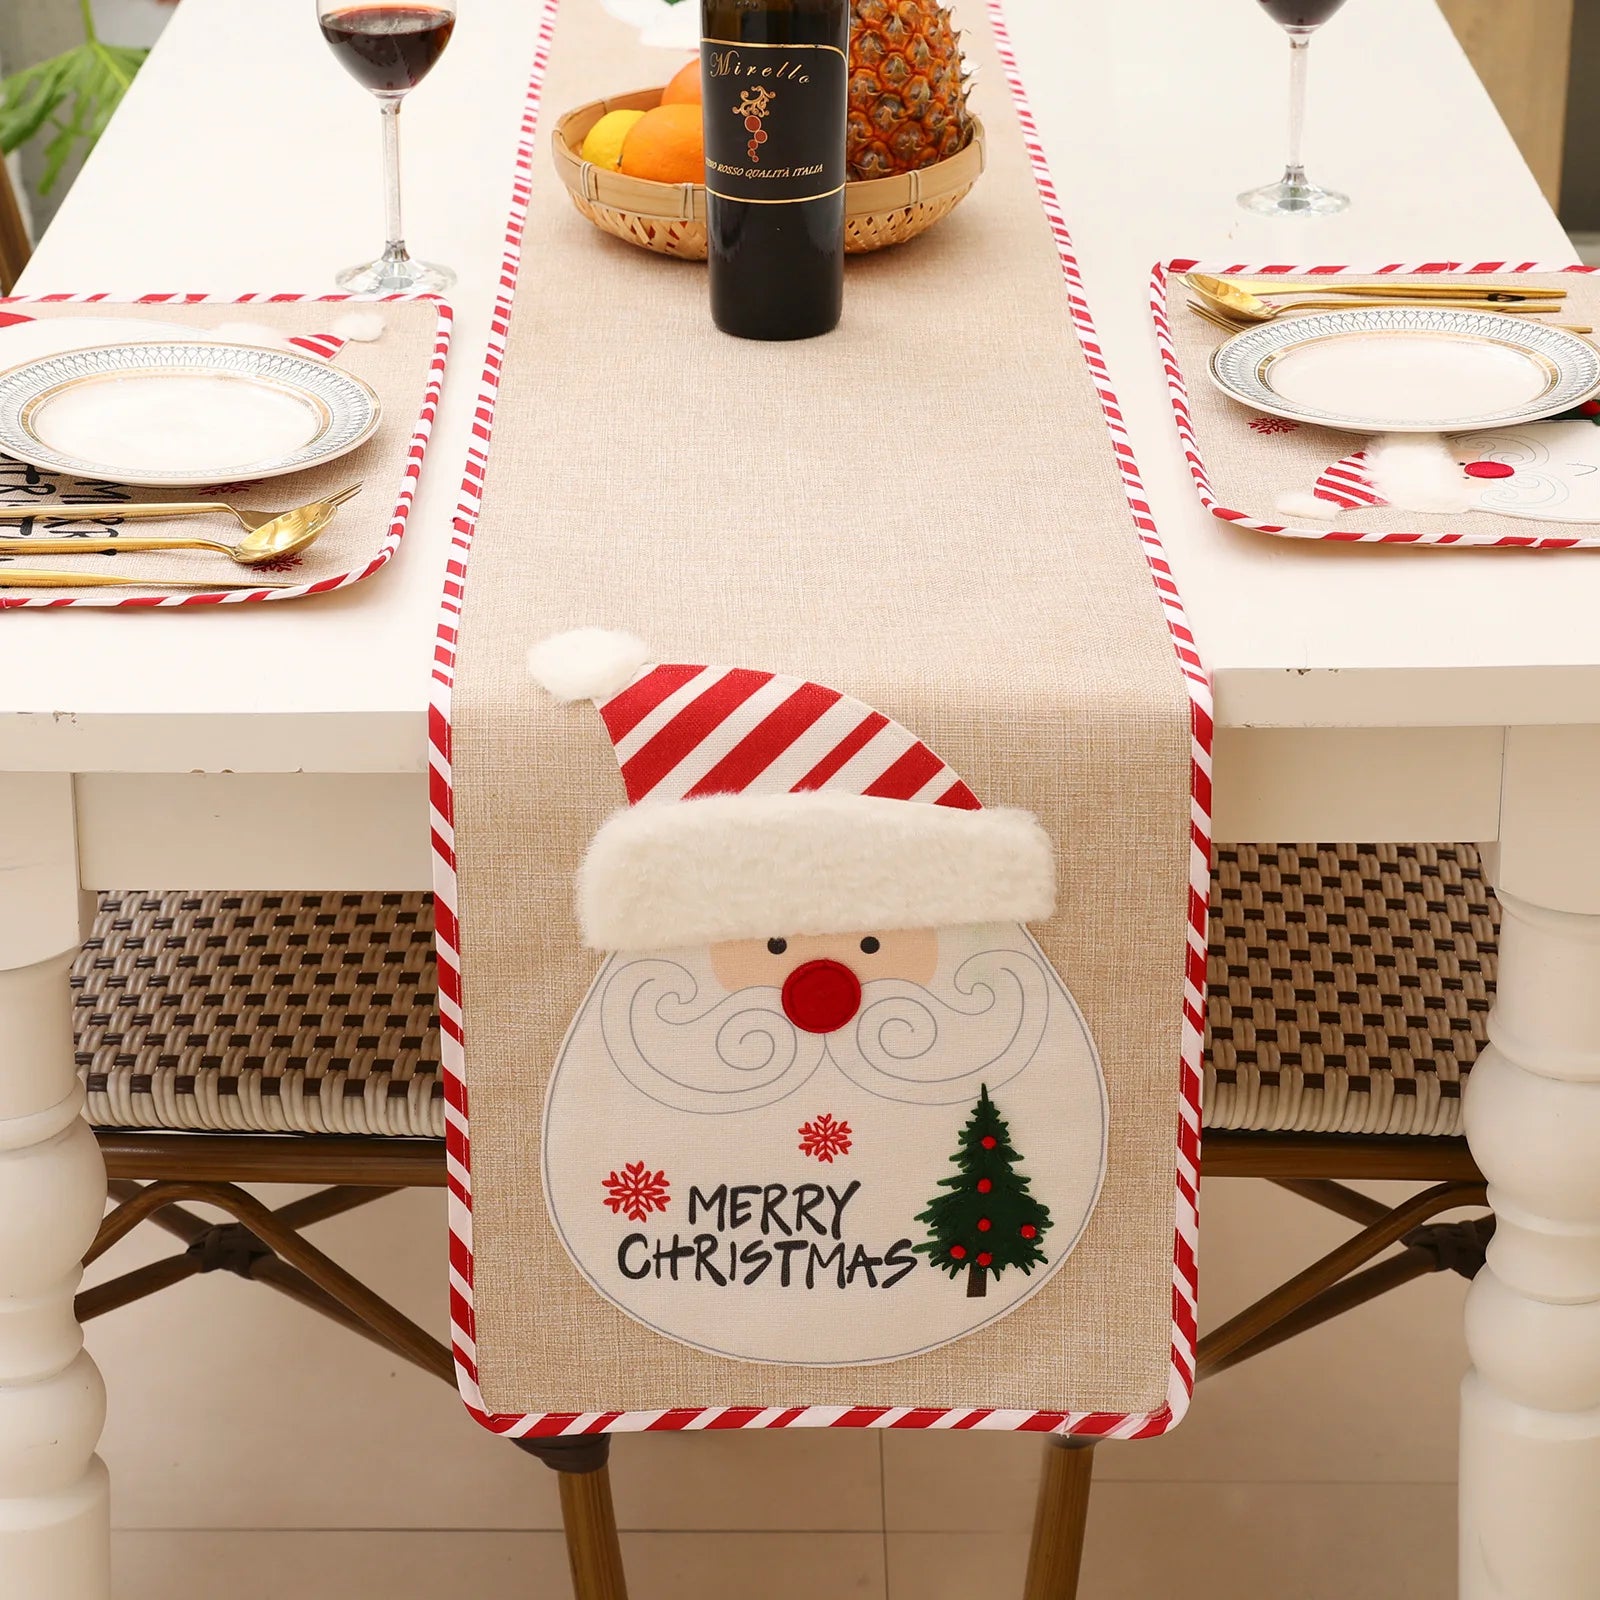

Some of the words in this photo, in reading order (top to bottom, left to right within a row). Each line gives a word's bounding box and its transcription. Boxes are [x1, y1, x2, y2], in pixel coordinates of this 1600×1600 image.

[709, 50, 811, 84] Mirello
[717, 163, 744, 176] ROSSO
[745, 167, 790, 179] QUALITÀ
[792, 163, 824, 177] ITALIA
[688, 1180, 861, 1240] MERRY
[617, 1233, 918, 1289] CHRISTMAS
